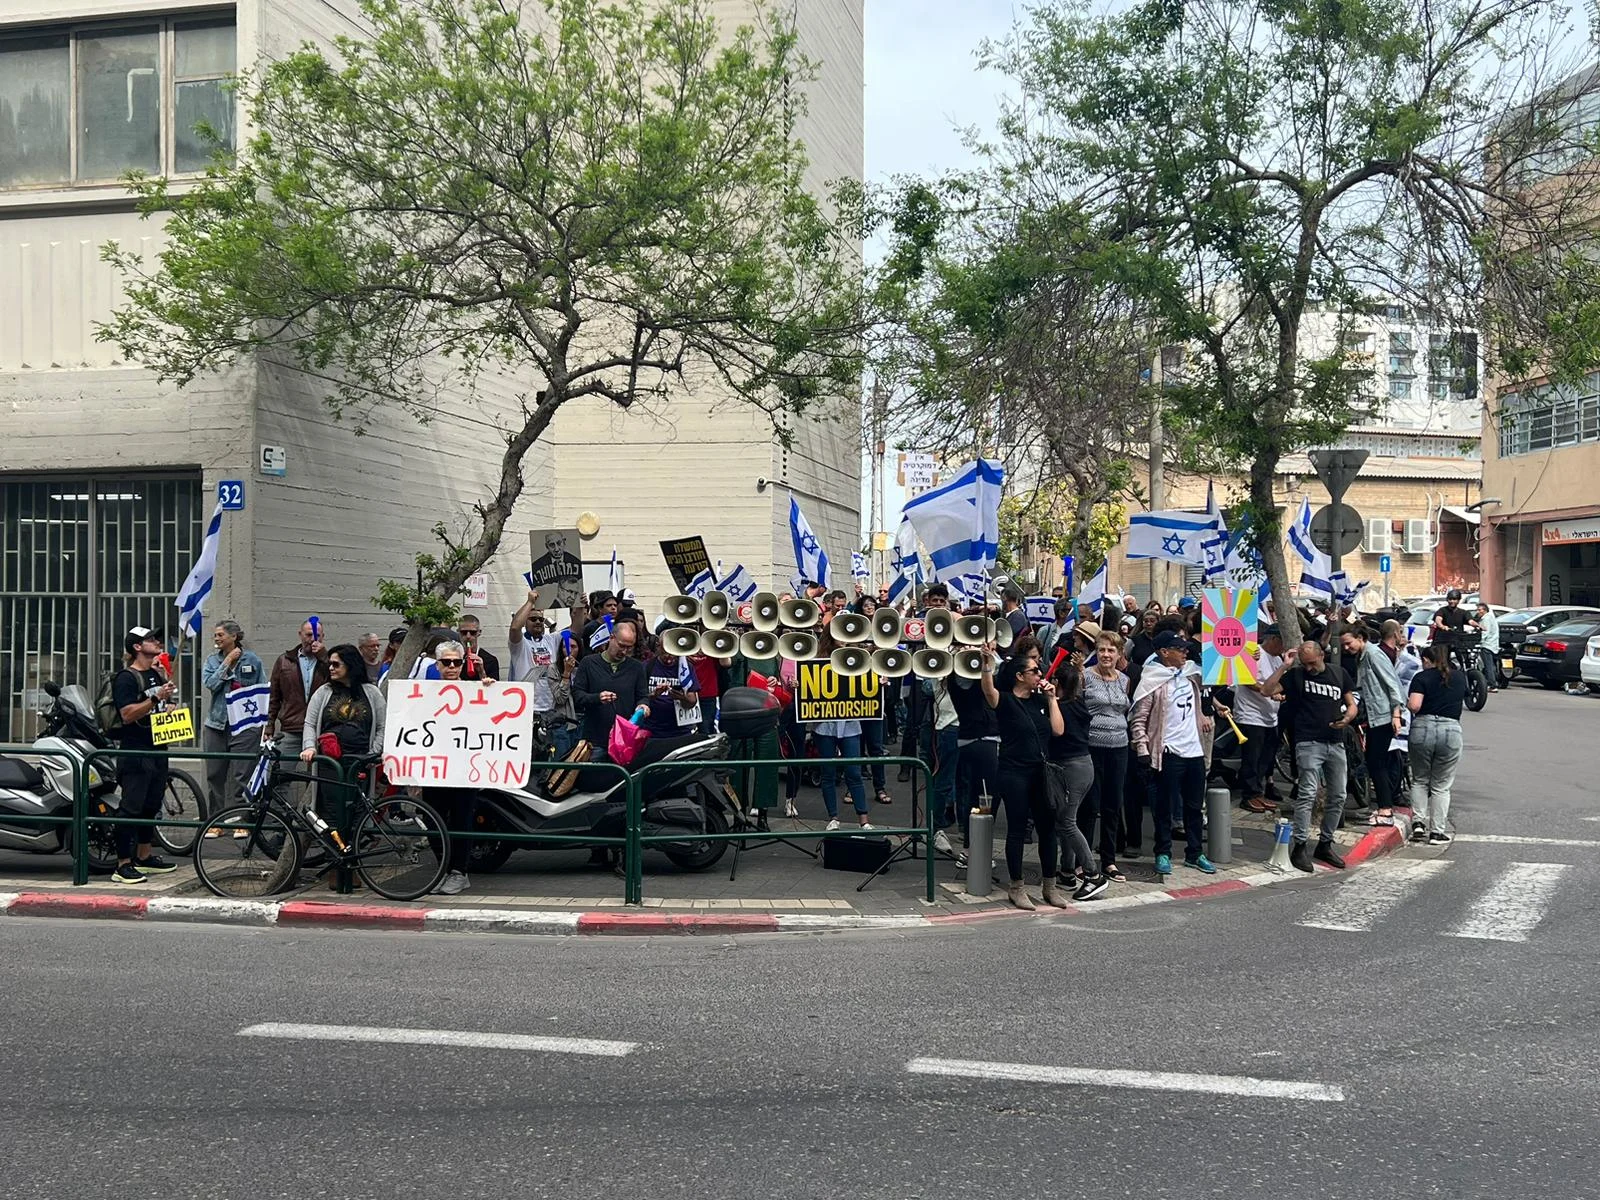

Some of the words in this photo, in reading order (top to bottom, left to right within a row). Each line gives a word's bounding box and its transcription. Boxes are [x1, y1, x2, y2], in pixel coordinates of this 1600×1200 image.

[903, 462, 937, 470] דמוקרטיה
[220, 484, 241, 504] 32
[1217, 637, 1231, 647] ביבי
[801, 663, 839, 700] NO
[407, 683, 527, 725] ביבי
[801, 700, 879, 719] DICTATORSHIP
[155, 712, 186, 726] חופש
[396, 720, 437, 748] לא
[451, 727, 520, 751] אתה
[384, 754, 449, 783] החוק
[468, 752, 526, 785] מעל
